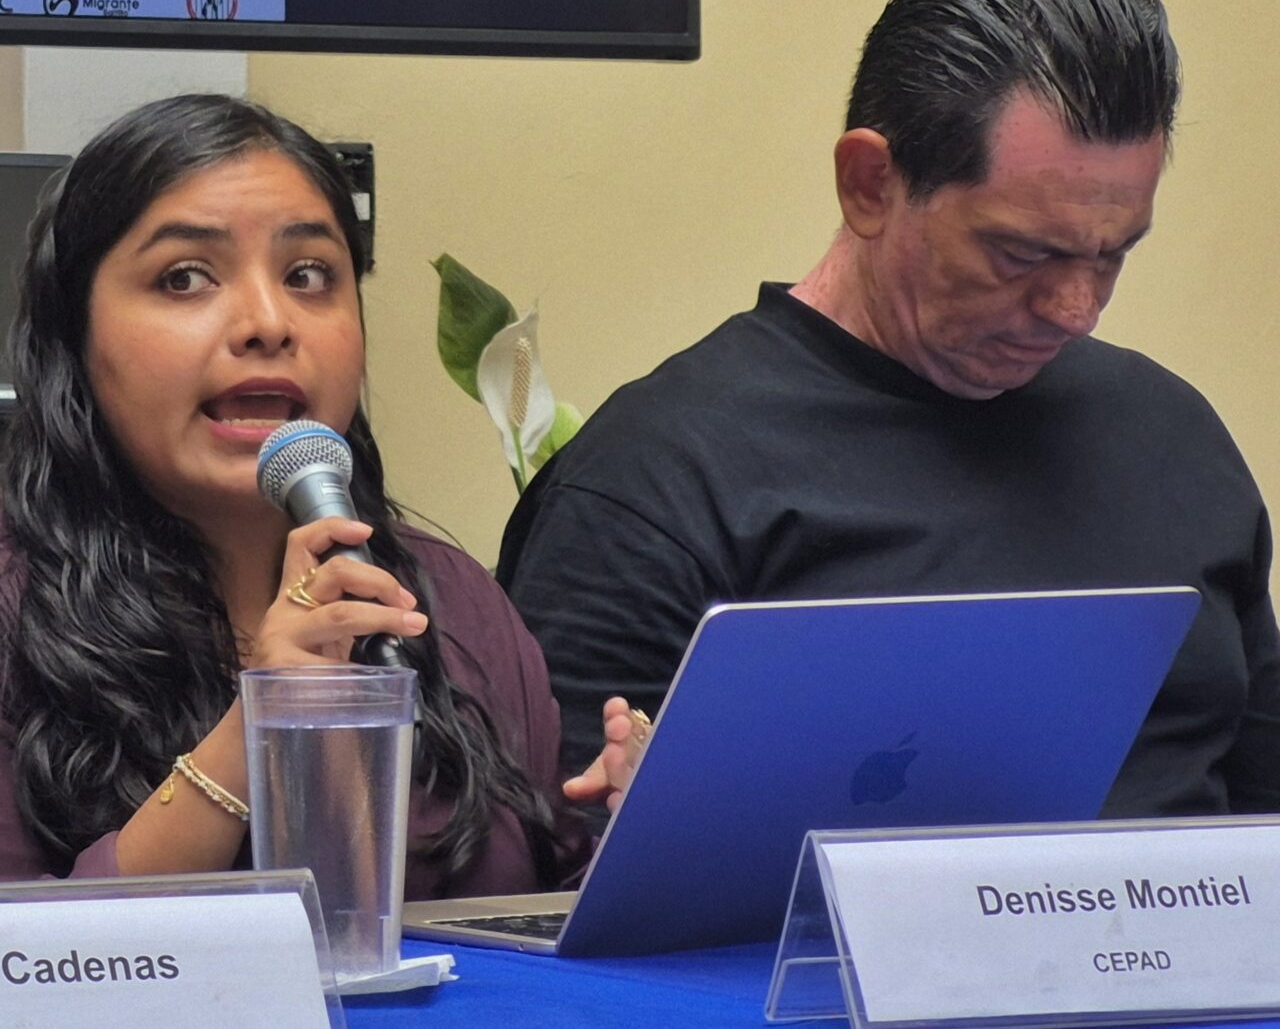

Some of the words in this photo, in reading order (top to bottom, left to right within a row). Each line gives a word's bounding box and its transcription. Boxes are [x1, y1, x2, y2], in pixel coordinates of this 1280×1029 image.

[976, 882, 1117, 917] Denisse
[1124, 874, 1252, 911] Montiel
[0, 950, 181, 986] Cadenas
[1092, 949, 1172, 974] CEPAD
